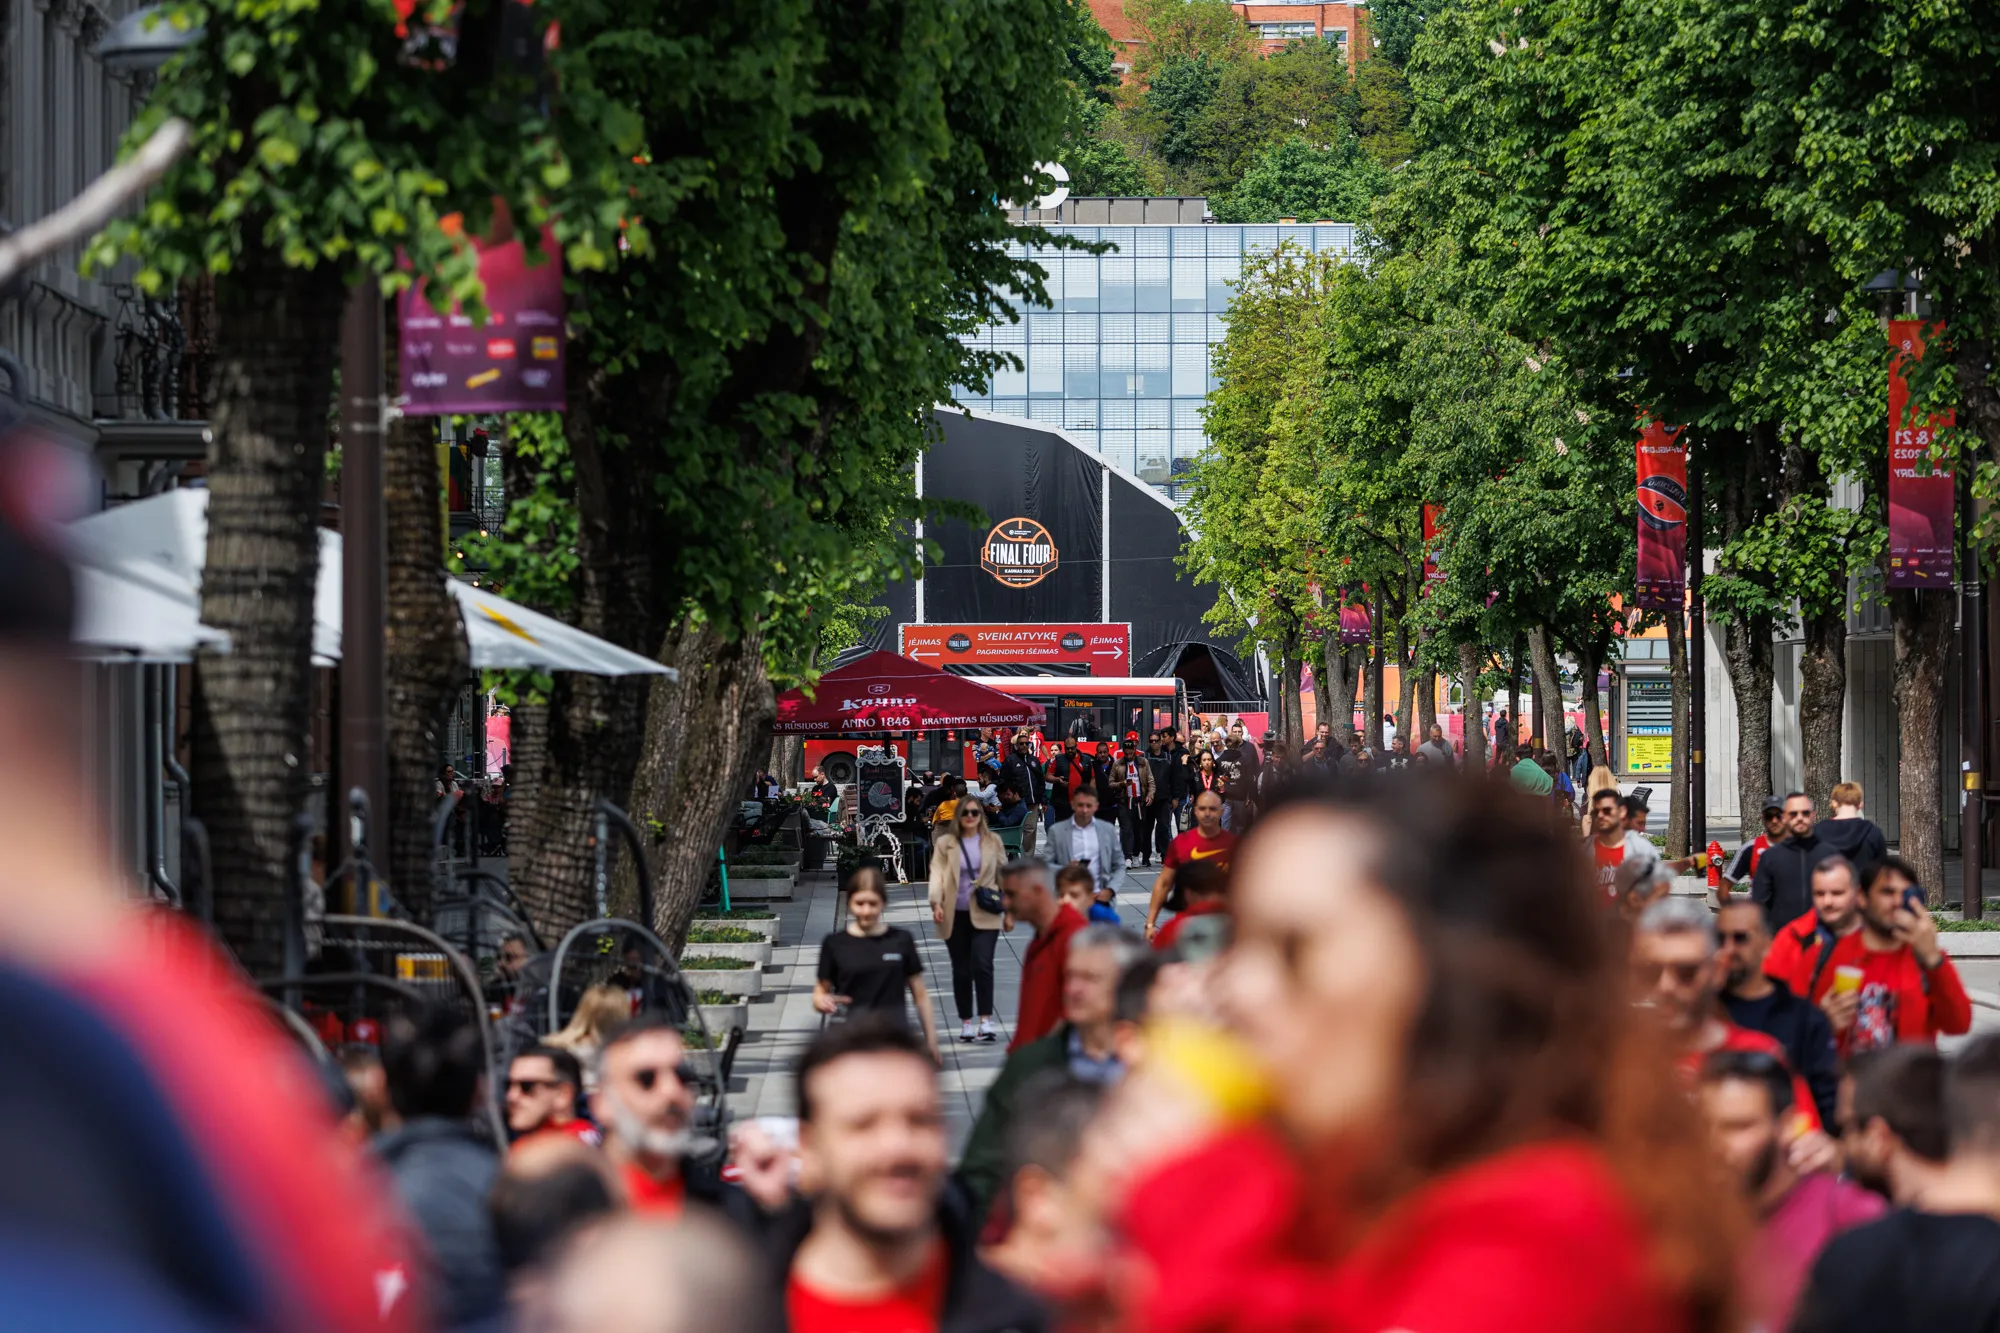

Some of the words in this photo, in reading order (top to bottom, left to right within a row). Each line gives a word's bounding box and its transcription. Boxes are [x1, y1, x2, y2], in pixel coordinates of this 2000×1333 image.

[990, 543, 1021, 566] FINAL
[1022, 543, 1051, 566] FOUR
[977, 632, 1013, 641] SVEIKI
[1013, 631, 1058, 642] ATVYKĘ
[1089, 636, 1124, 646] ĮĖJIMAS
[908, 637, 942, 647] ĮĖJIMAS
[976, 648, 1024, 656] PAGRINDINIS
[1025, 647, 1059, 655] IŠĖJIMAS
[841, 717, 876, 729] ANNO
[881, 716, 910, 727] 1846
[922, 715, 978, 726] BRANDINTAS
[979, 713, 1025, 724] RŪSIUOSE
[784, 720, 830, 730] RŪSIUOSE
